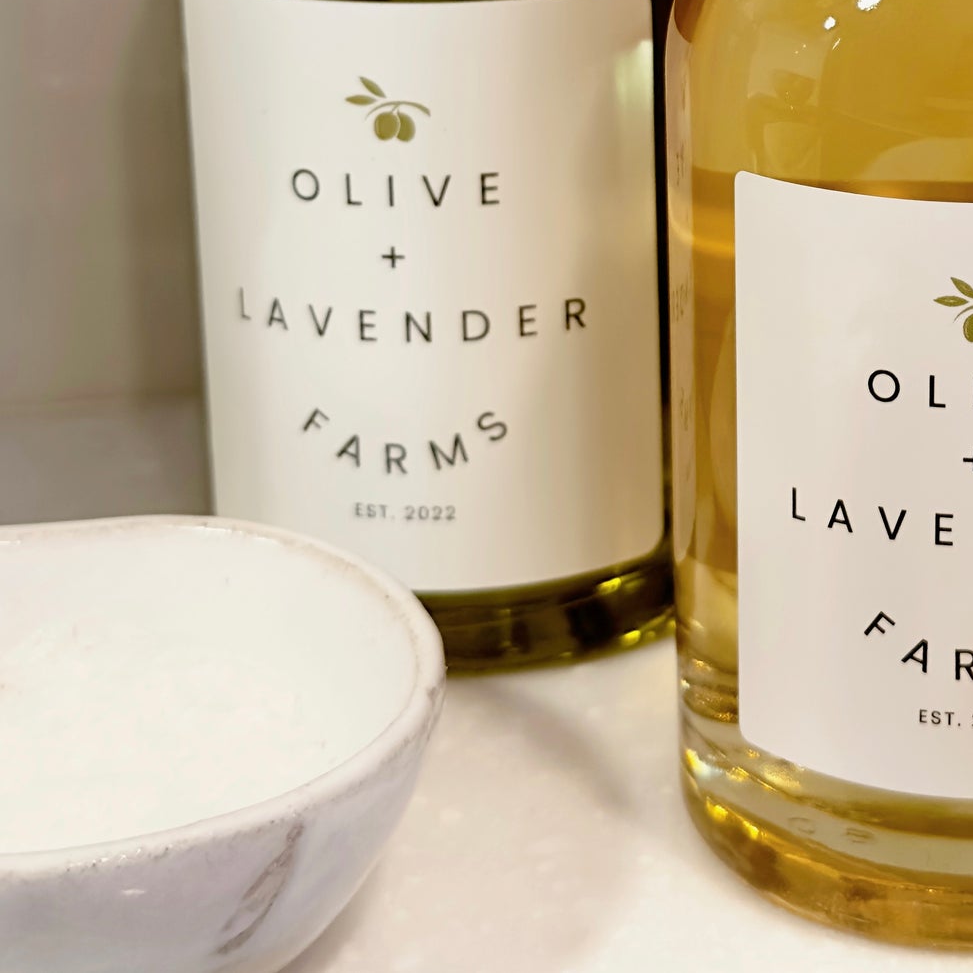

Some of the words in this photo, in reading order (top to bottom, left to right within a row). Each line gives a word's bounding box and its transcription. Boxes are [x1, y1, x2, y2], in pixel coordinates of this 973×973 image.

[291, 168, 501, 208] OLIVE
[381, 246, 406, 269] +
[238, 287, 587, 343] LAVENDER
[301, 407, 509, 475] FARMS
[353, 501, 396, 521] EST.
[404, 504, 457, 523] 2022
[917, 708, 963, 728] EST.
